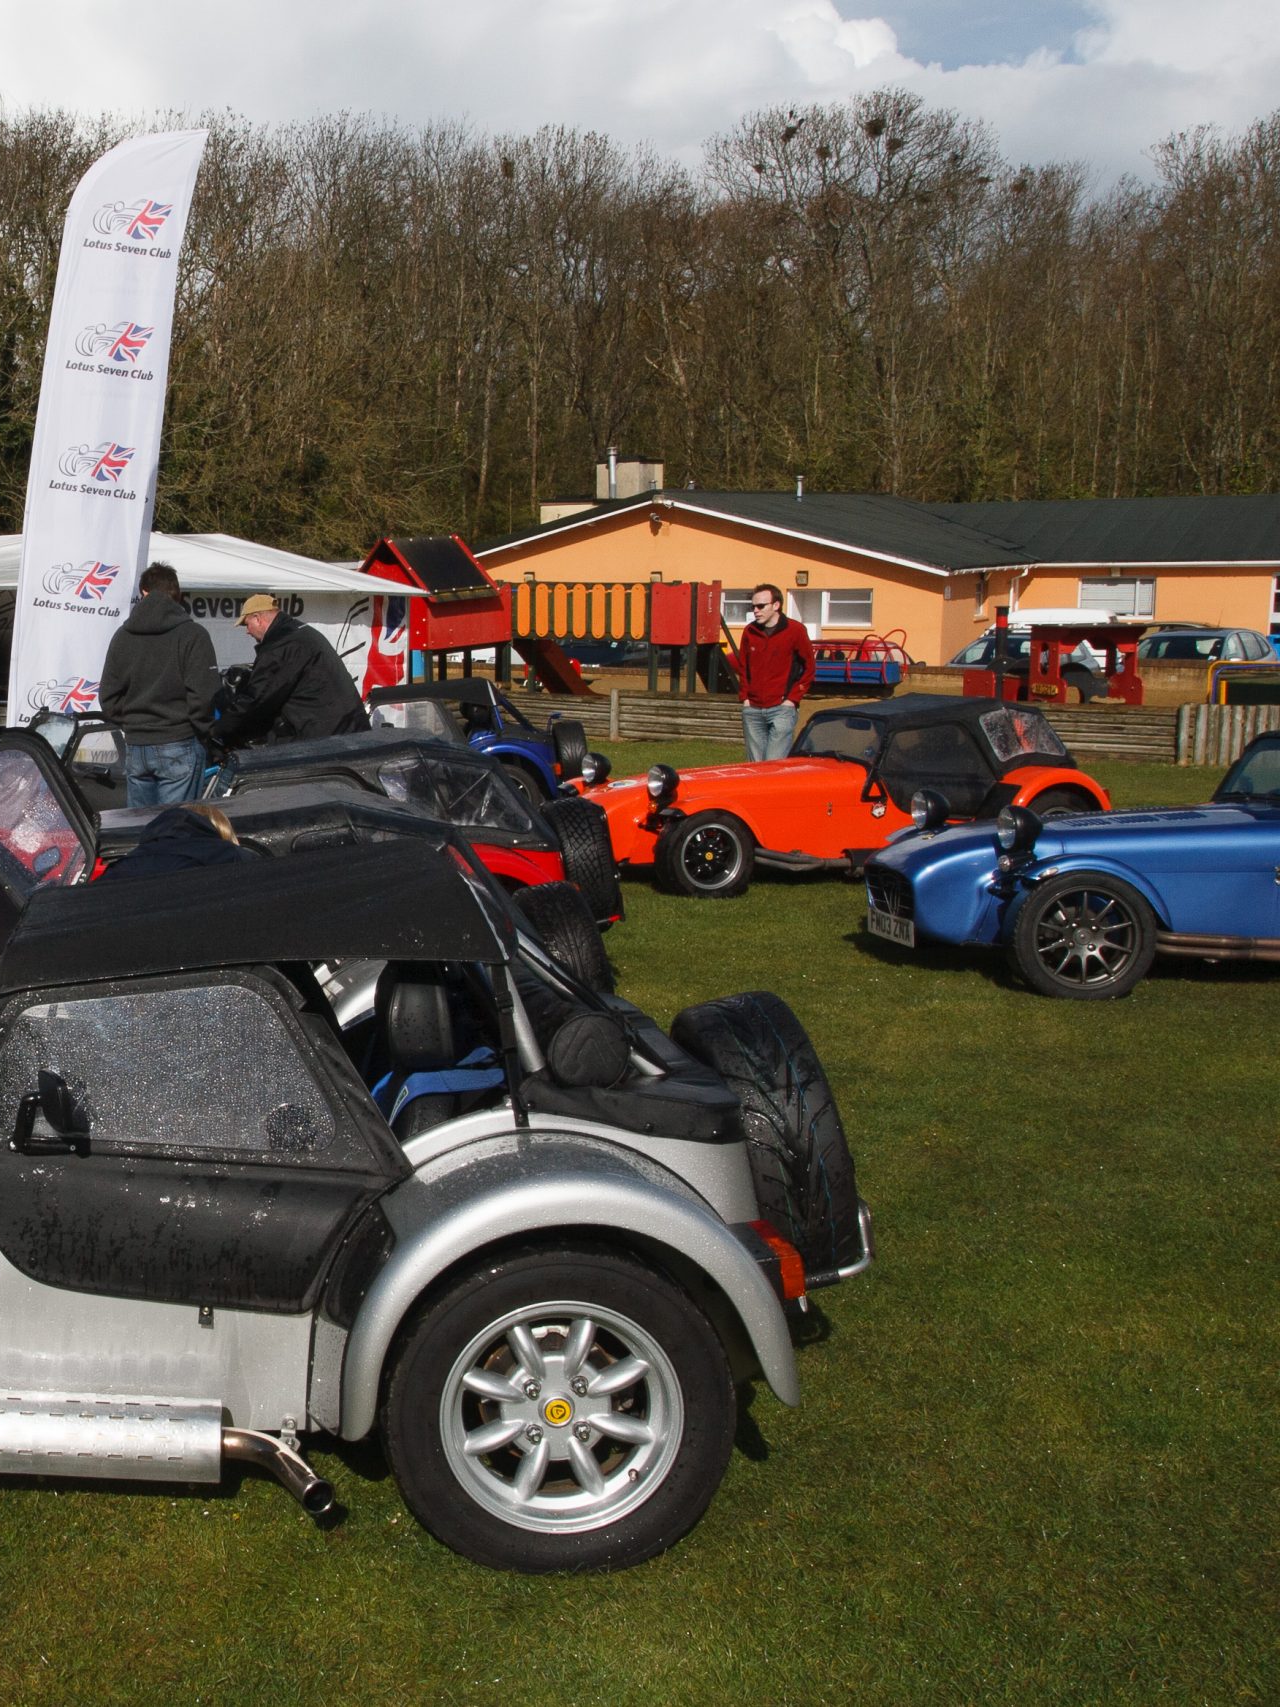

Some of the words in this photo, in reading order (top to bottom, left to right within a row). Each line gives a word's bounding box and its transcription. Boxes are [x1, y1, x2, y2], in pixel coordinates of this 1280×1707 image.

[83, 238, 112, 251] Lotus
[114, 242, 147, 256] Seven
[149, 247, 172, 259] Club
[65, 359, 94, 373] Lotus
[96, 364, 128, 377] Seven
[130, 369, 154, 381] Club
[48, 480, 77, 493] Lotus
[79, 484, 111, 497] Seven
[113, 488, 136, 501] Club
[33, 597, 62, 610] Lotus
[63, 602, 95, 615] Seven
[97, 605, 121, 618] Club
